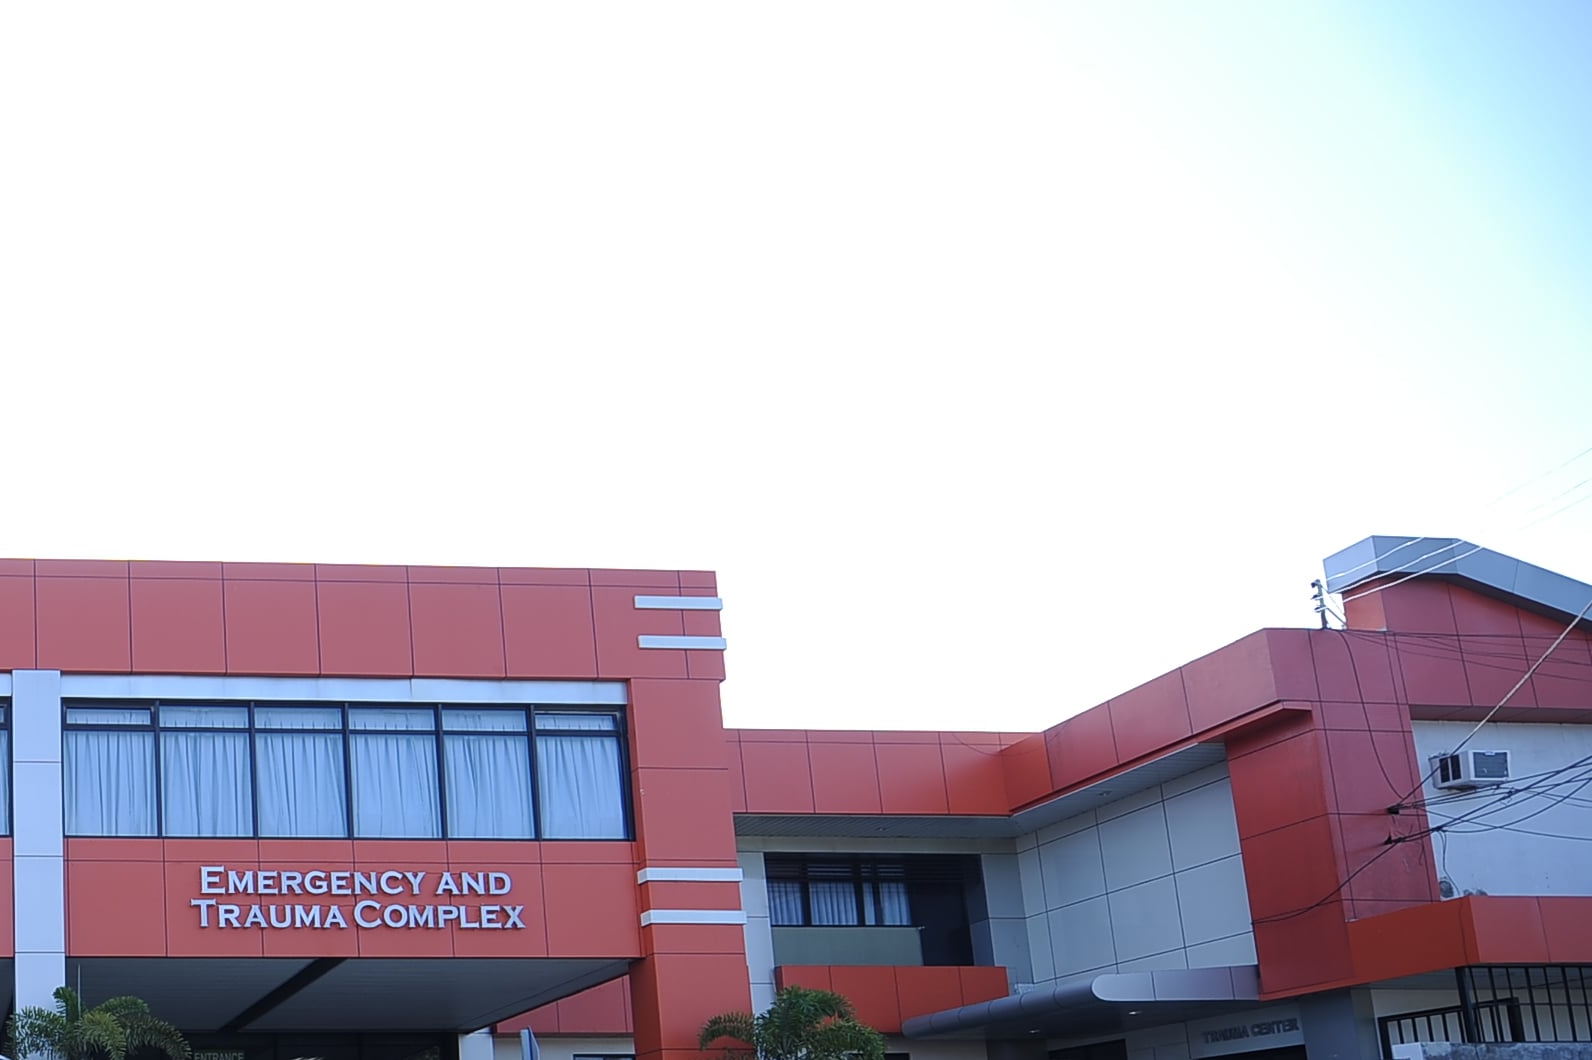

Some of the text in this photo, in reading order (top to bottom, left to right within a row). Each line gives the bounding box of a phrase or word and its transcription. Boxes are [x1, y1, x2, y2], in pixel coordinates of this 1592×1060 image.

[199, 865, 512, 896] EMERGENCY AND
[190, 898, 527, 930] TRAUMA COMPLEX
[1202, 1018, 1300, 1044] TRAUMA CENTER
